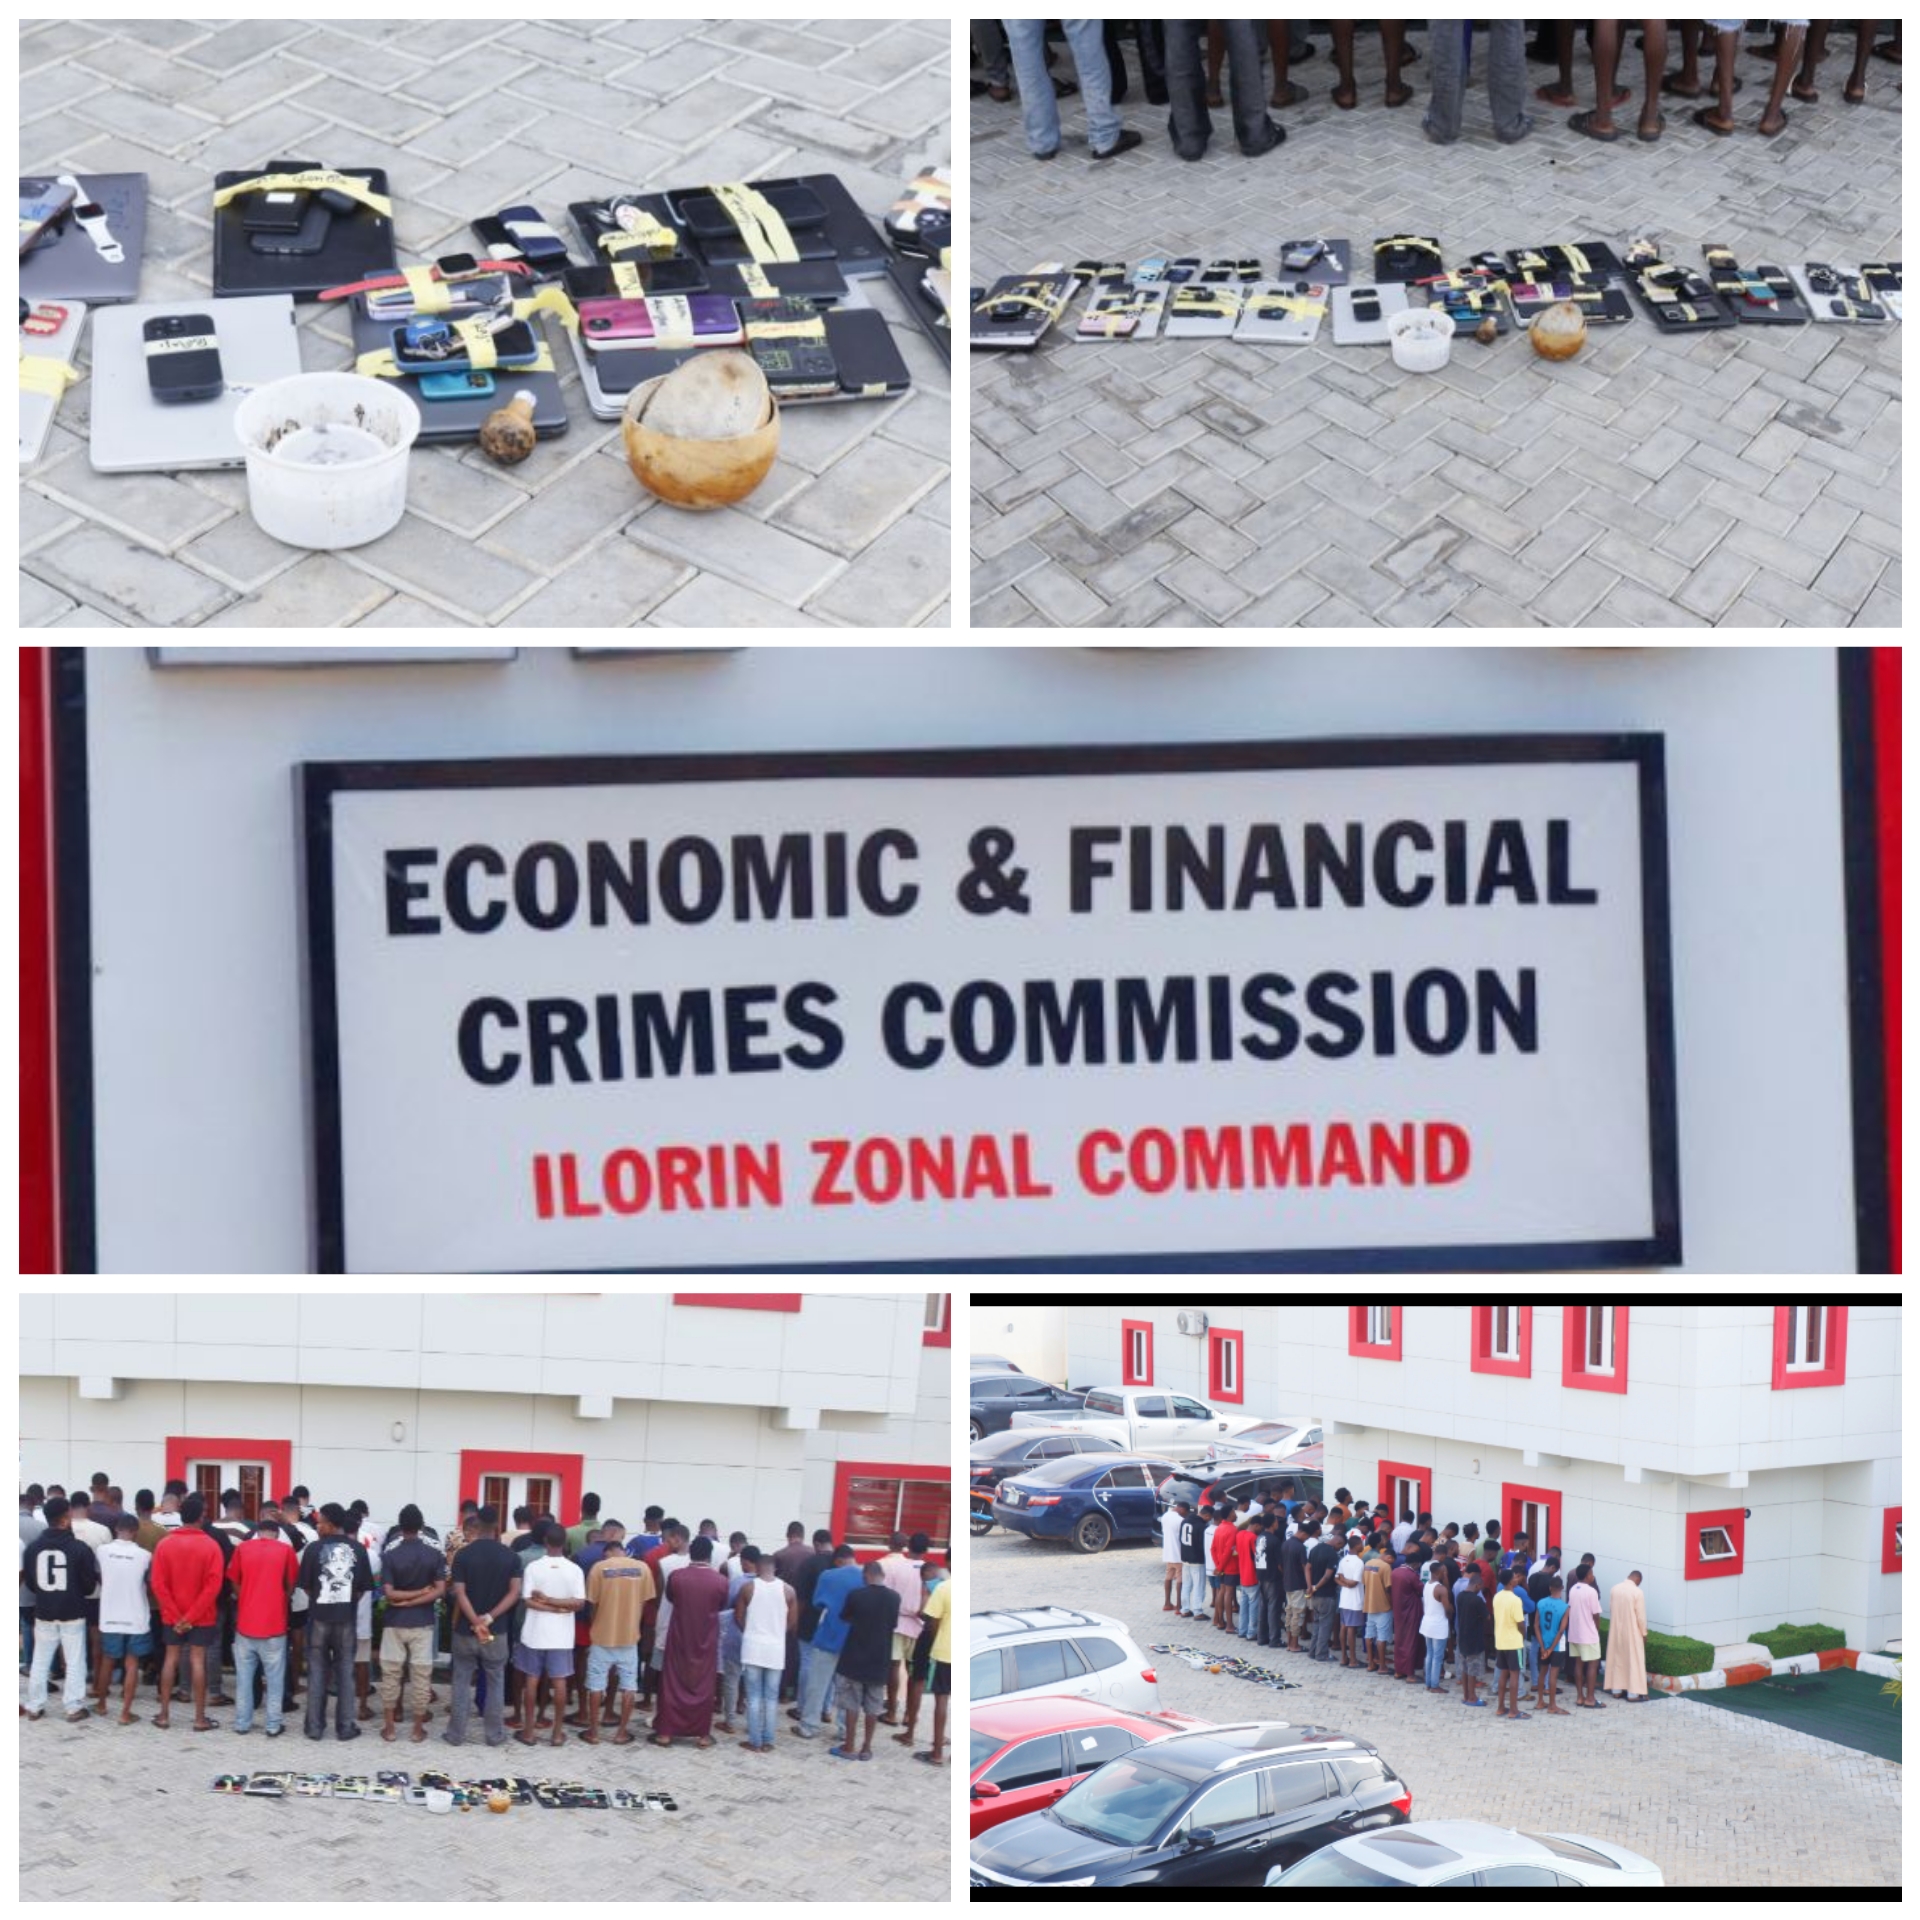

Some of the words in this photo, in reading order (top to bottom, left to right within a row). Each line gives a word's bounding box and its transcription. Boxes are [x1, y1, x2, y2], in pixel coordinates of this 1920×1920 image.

[385, 829, 919, 937] ECONOMIC
[957, 827, 1031, 915] &
[1070, 819, 1598, 914] FINANCIAL
[457, 981, 844, 1086] CRIMES
[882, 968, 1539, 1069] COMMISSION
[532, 1143, 784, 1219] ILORIN
[811, 1133, 1053, 1206] ZONAL
[1079, 1121, 1472, 1197] COMMAND
[1181, 1522, 1193, 1547] G
[36, 1549, 67, 1592] G
[1545, 1611, 1553, 1630] 9
